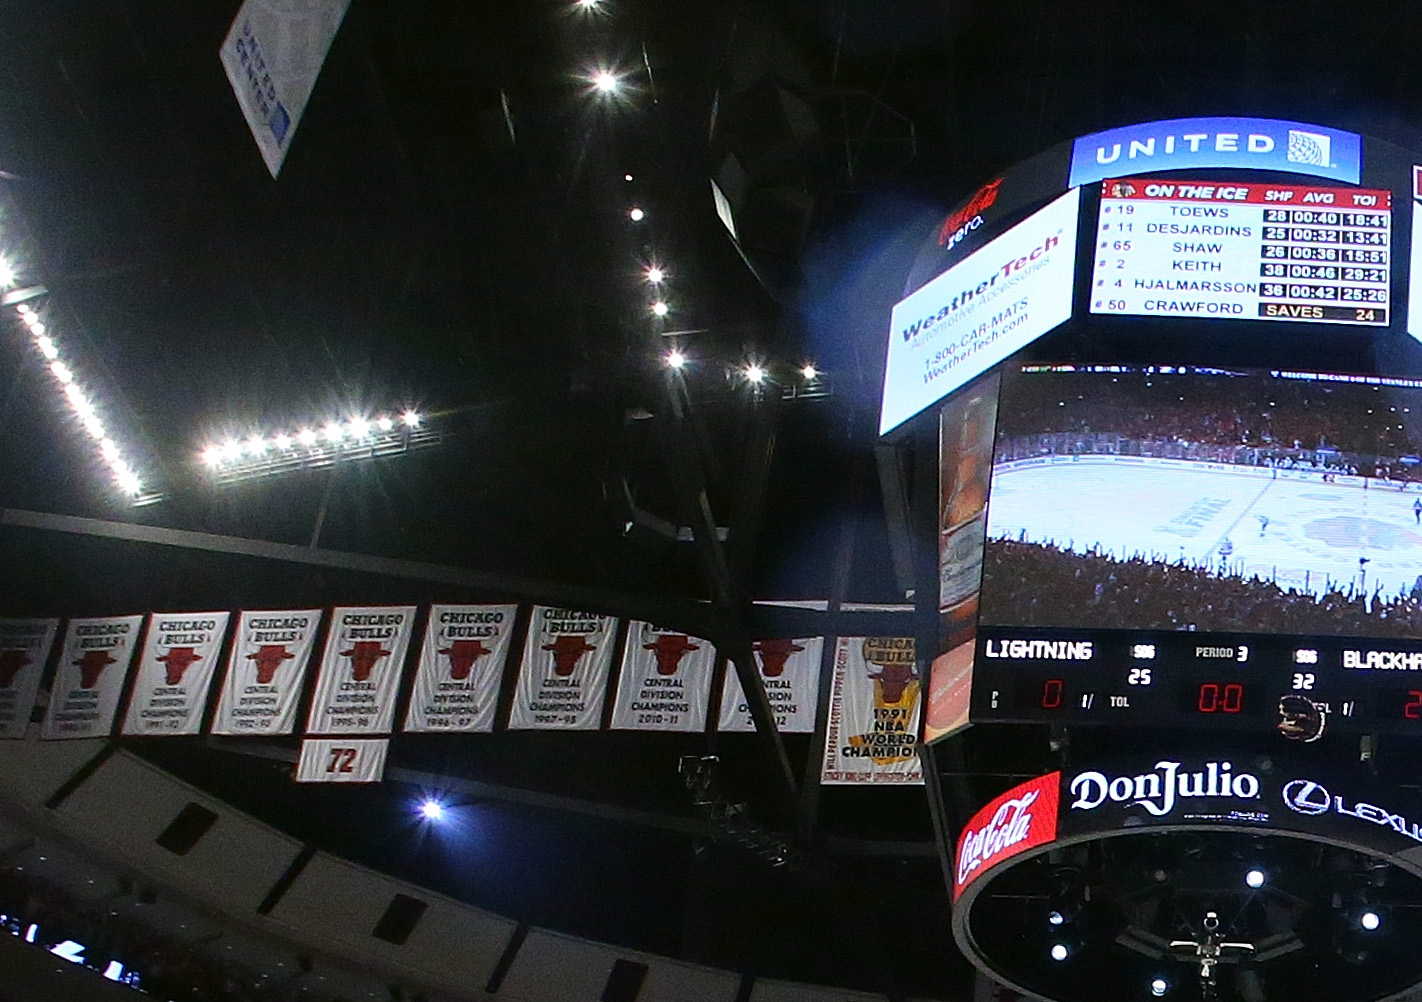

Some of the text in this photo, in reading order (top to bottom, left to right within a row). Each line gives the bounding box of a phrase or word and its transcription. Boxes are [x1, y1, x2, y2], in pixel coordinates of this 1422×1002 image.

[1095, 132, 1276, 166] UNITED
[1144, 184, 1248, 201] ON THE ICE
[1302, 192, 1334, 204] AVG
[1353, 194, 1377, 206] TOI
[1117, 205, 1387, 227] 19 TOEWS 28 00:40 18:41
[1117, 223, 1387, 245] 11 DESJARDINS 25 00:32 13:41
[1113, 241, 1387, 263] 65 SHAW 26 00:36 15:51
[1116, 260, 1386, 282] 2 KEITH 38 00:46 29:21
[902, 232, 1059, 343] WeatherTech
[1114, 278, 1386, 302] 4 HJALMARSSON 36 00:42 25:26
[1108, 300, 1375, 321] 50 CRAWFORD SAVES 24
[924, 296, 1028, 370] 1-800-CAR-MATS
[923, 313, 1029, 385] WeatherTech.com
[250, 617, 308, 629] CHICAGO
[342, 613, 403, 626] CHICAGO
[440, 612, 504, 624] CHICAGO
[159, 620, 216, 632] CHICAGO
[349, 627, 393, 639] BULLS
[447, 625, 493, 638] BULLS
[550, 621, 597, 633] BULLS
[166, 634, 204, 645] BULLS
[254, 631, 297, 643] BULLS
[986, 640, 1093, 660] LIGHTNING
[1196, 646, 1233, 658] PERIOD
[1236, 646, 1248, 662] 3
[644, 678, 684, 688] CENTRAL
[1128, 668, 1315, 690] 25 32
[641, 690, 684, 700] DIVISION
[1042, 679, 1063, 708] 0
[631, 702, 689, 712] CHAMPIONS
[873, 708, 907, 719] 1991
[875, 721, 904, 732] NBA
[861, 733, 915, 745] WORLD
[327, 748, 357, 773] 72
